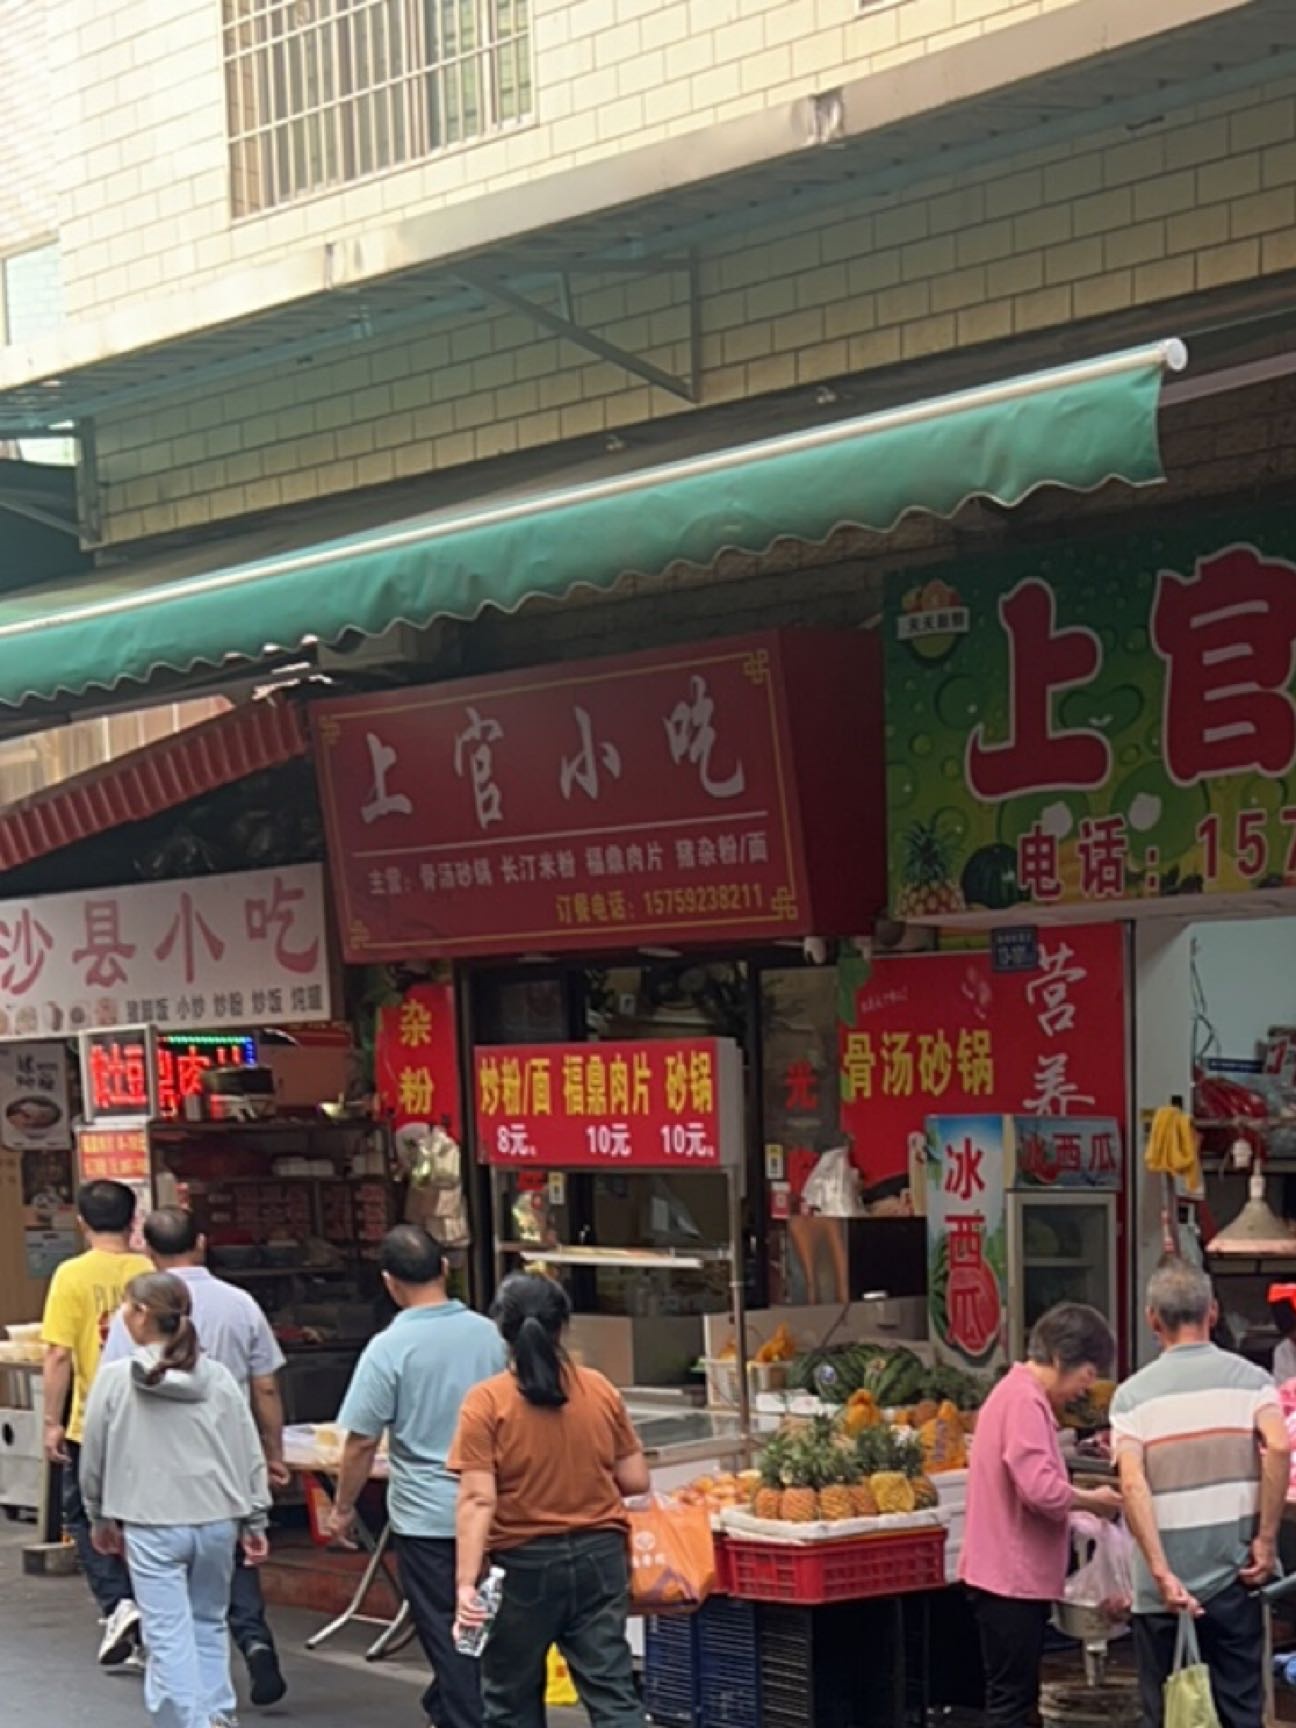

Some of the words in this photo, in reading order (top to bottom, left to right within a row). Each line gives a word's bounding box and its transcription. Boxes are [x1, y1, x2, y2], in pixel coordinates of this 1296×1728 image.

[361, 674, 745, 829] 上官小吃
[0, 876, 320, 994] 沙县小吃
[562, 1050, 652, 1116] 福鼎肉片
[665, 1048, 714, 1116] 砂锅
[843, 1028, 995, 1099] 骨汤砂锅
